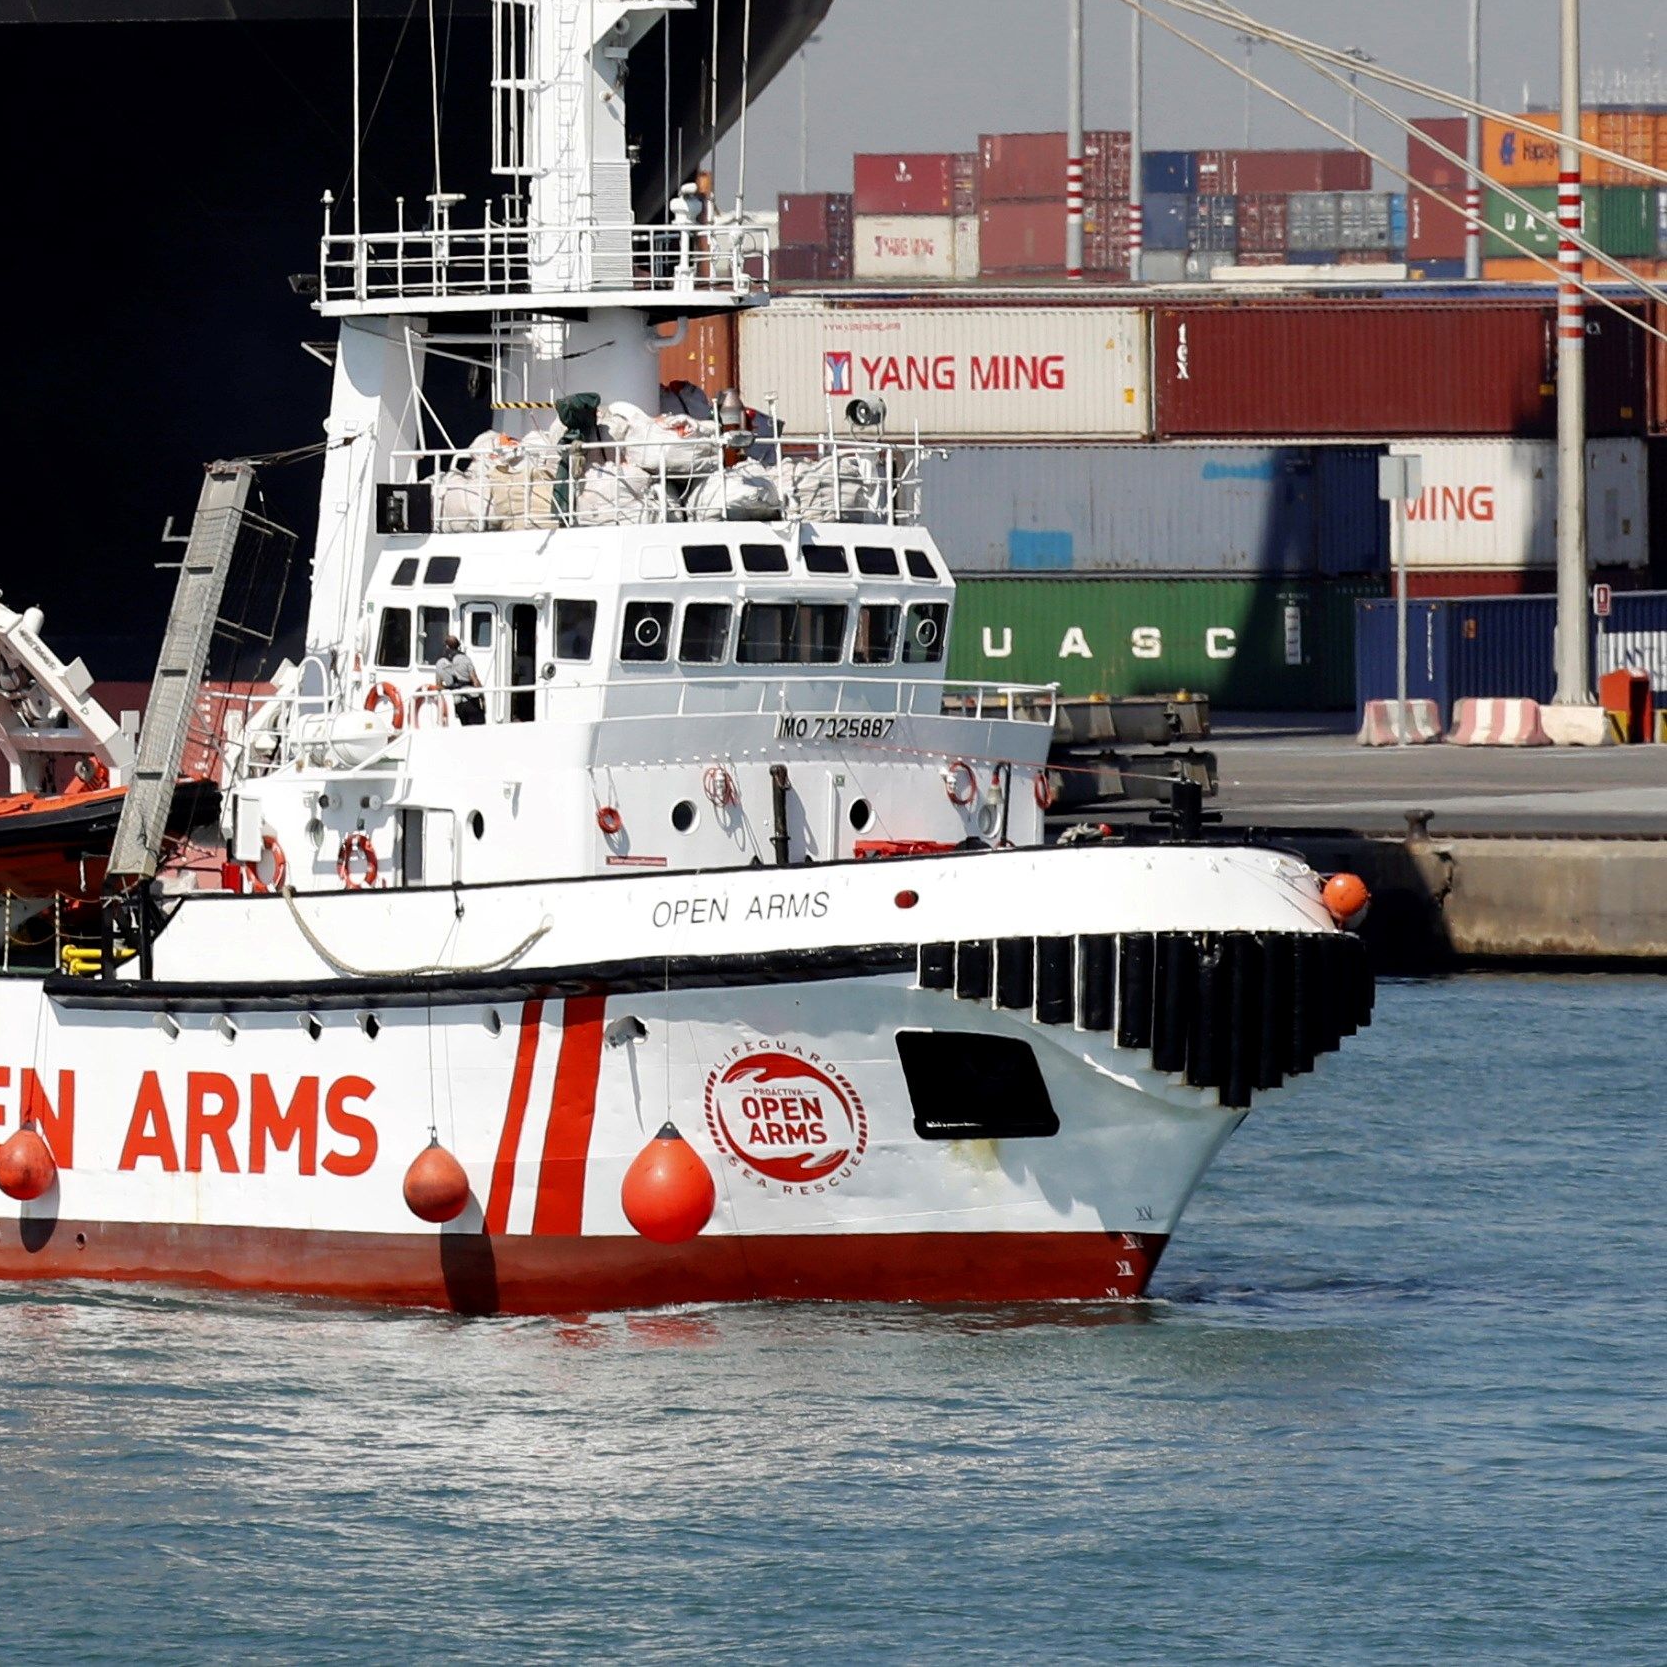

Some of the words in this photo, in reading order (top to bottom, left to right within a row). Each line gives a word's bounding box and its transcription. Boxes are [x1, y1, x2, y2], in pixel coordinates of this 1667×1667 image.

[860, 355, 956, 392] YANG
[970, 354, 1066, 391] MING
[777, 718, 808, 739] IMO
[812, 717, 895, 739] 7325887
[652, 897, 729, 928] OPEN
[745, 891, 830, 922] ARMS
[717, 1040, 837, 1074] LIFEGUARD
[741, 1096, 824, 1121] OPEN
[753, 1088, 803, 1096] PROACTIVA
[117, 1069, 379, 1177] ARMS
[748, 1122, 828, 1145] ARMS
[727, 1156, 768, 1189] SEA
[782, 1157, 862, 1196] RESCUE
